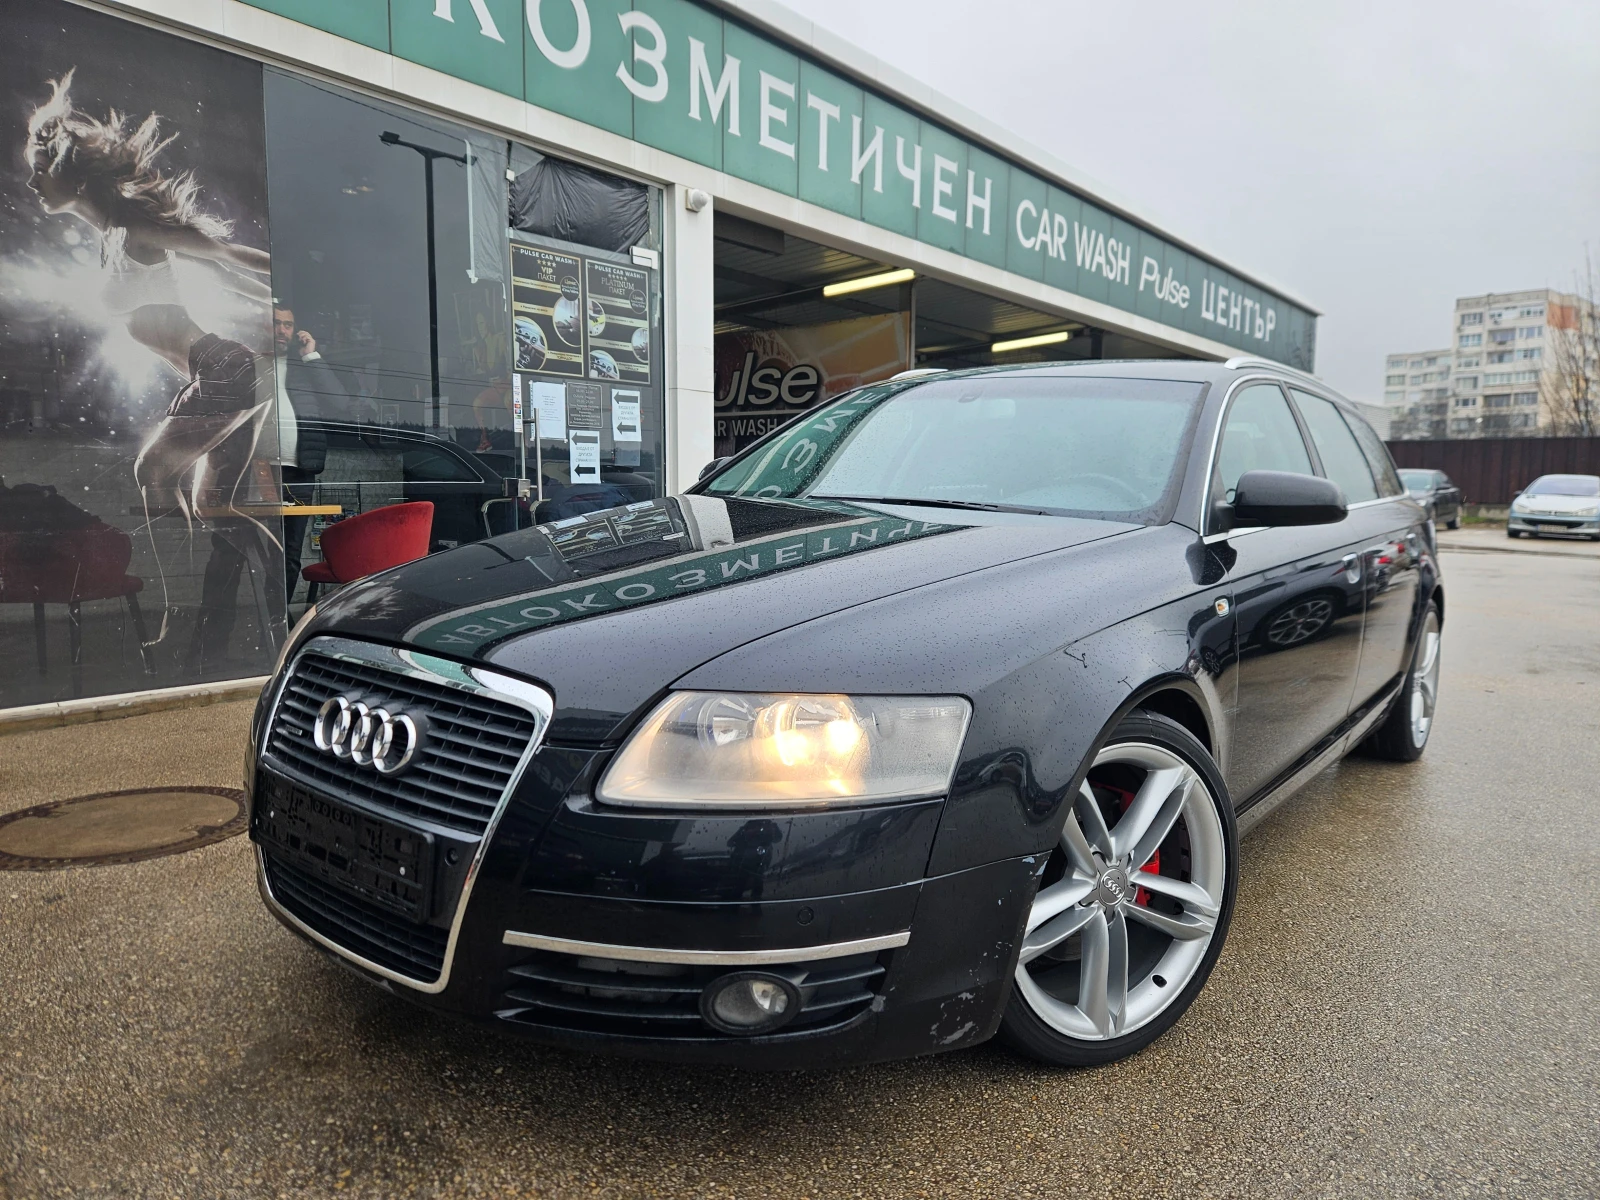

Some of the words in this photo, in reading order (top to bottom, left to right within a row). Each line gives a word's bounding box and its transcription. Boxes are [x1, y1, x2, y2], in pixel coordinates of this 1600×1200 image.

[520, 248, 540, 258] PULSE
[554, 255, 573, 265] WASH
[537, 272, 557, 282] ПАКЕТ
[541, 266, 553, 275] VIP
[594, 264, 612, 273] PULSE
[624, 271, 641, 279] WASH
[1016, 199, 1068, 261] CAR
[1073, 221, 1131, 286] WASH
[1139, 256, 1191, 309] Pulse
[1200, 278, 1277, 342] ЦЕНТЪР
[601, 277, 635, 291] PLATINUM
[608, 286, 626, 296] ПАКЕТ
[714, 352, 818, 407] ulse
[732, 418, 777, 437] WASH
